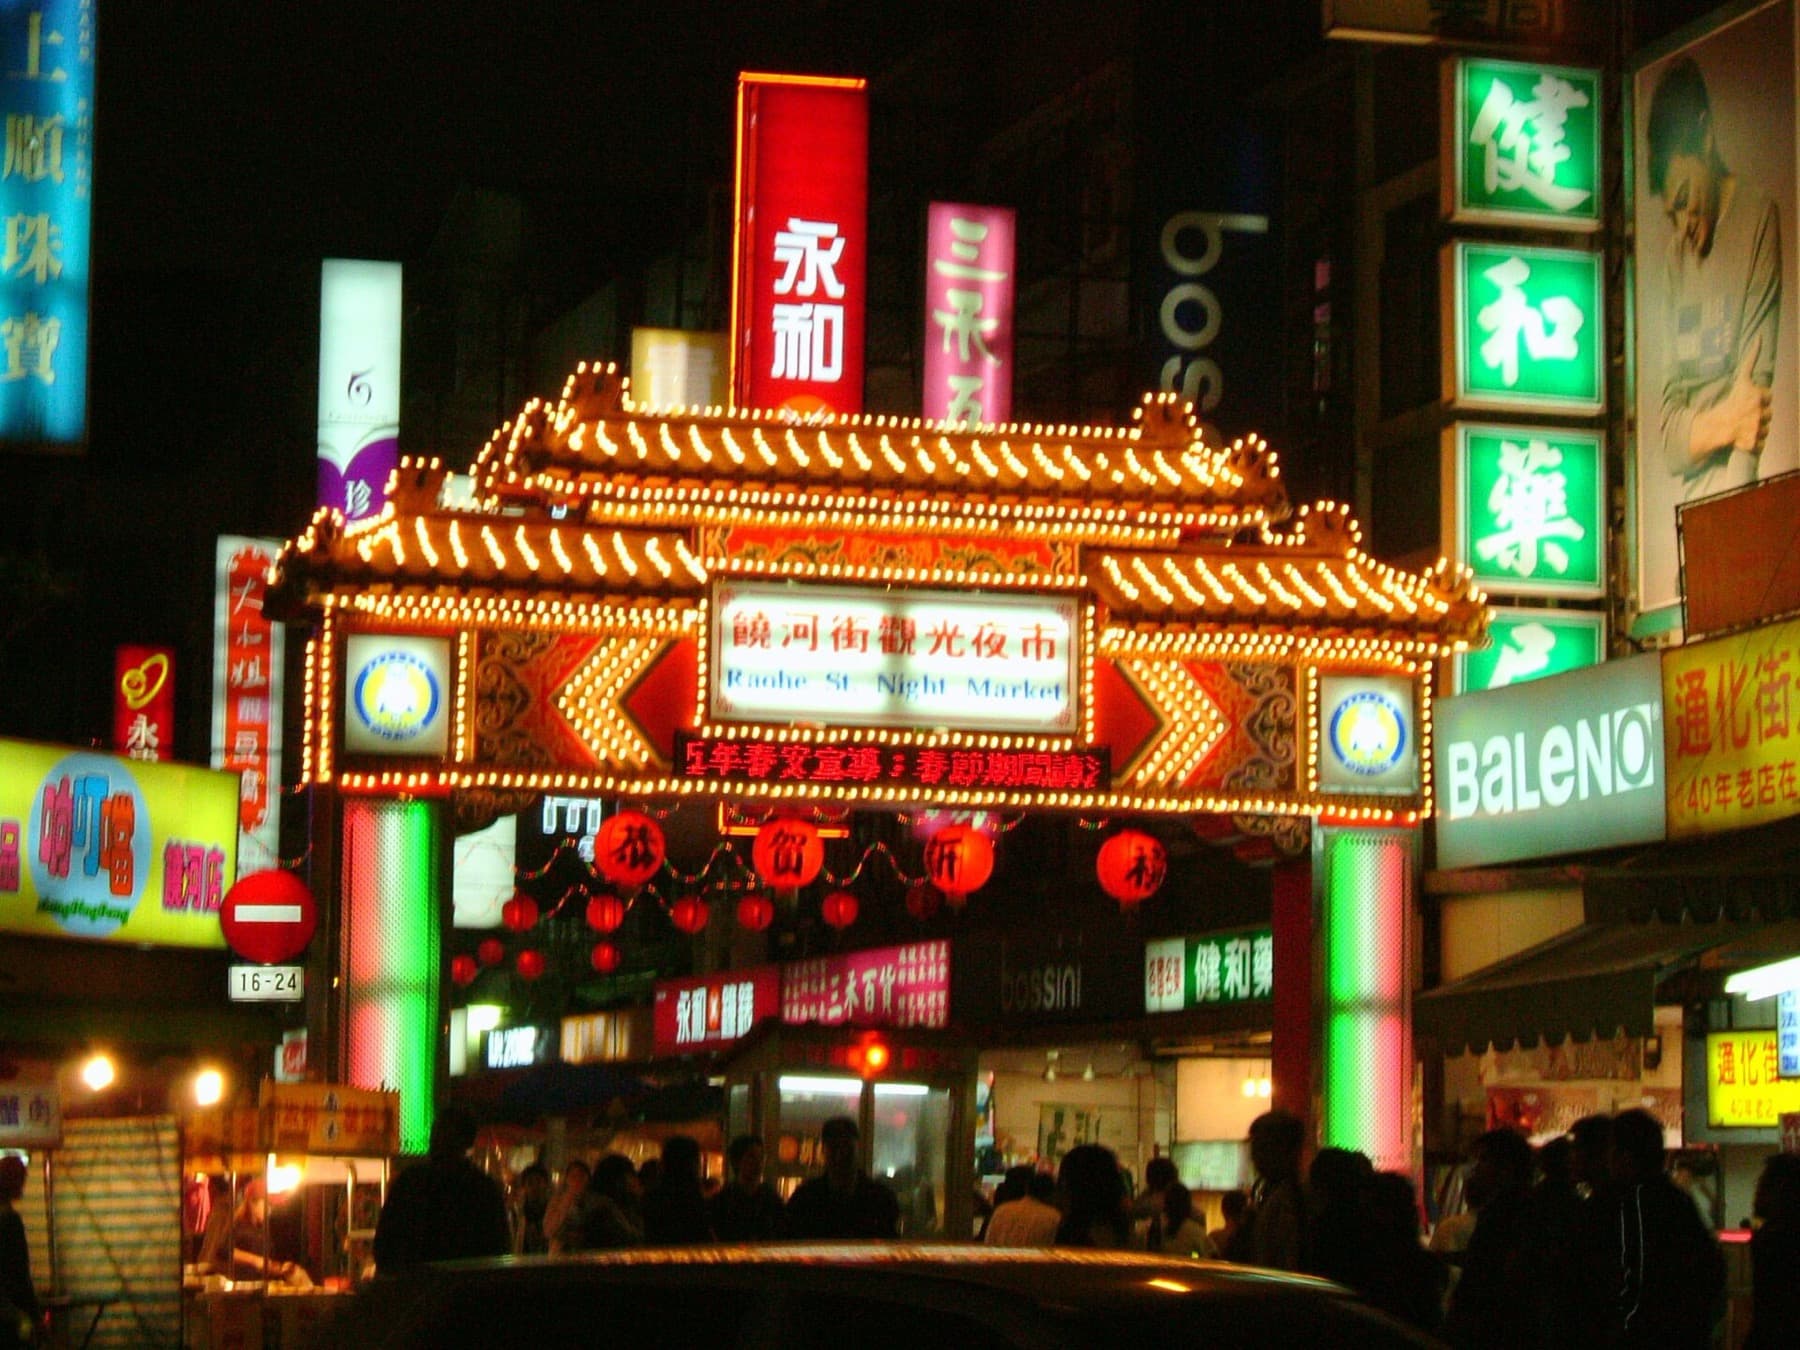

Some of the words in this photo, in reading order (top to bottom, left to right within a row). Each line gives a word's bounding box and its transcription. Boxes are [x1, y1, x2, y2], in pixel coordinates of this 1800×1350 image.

[770, 217, 846, 382] 永和
[1160, 211, 1268, 446] bos
[733, 611, 1057, 661] 饒河街觀光夜市
[727, 669, 808, 689] Raohe
[877, 672, 945, 701] Night
[967, 677, 1062, 701] Market
[1675, 650, 1800, 760] 通化街
[240, 972, 297, 992] 16-24
